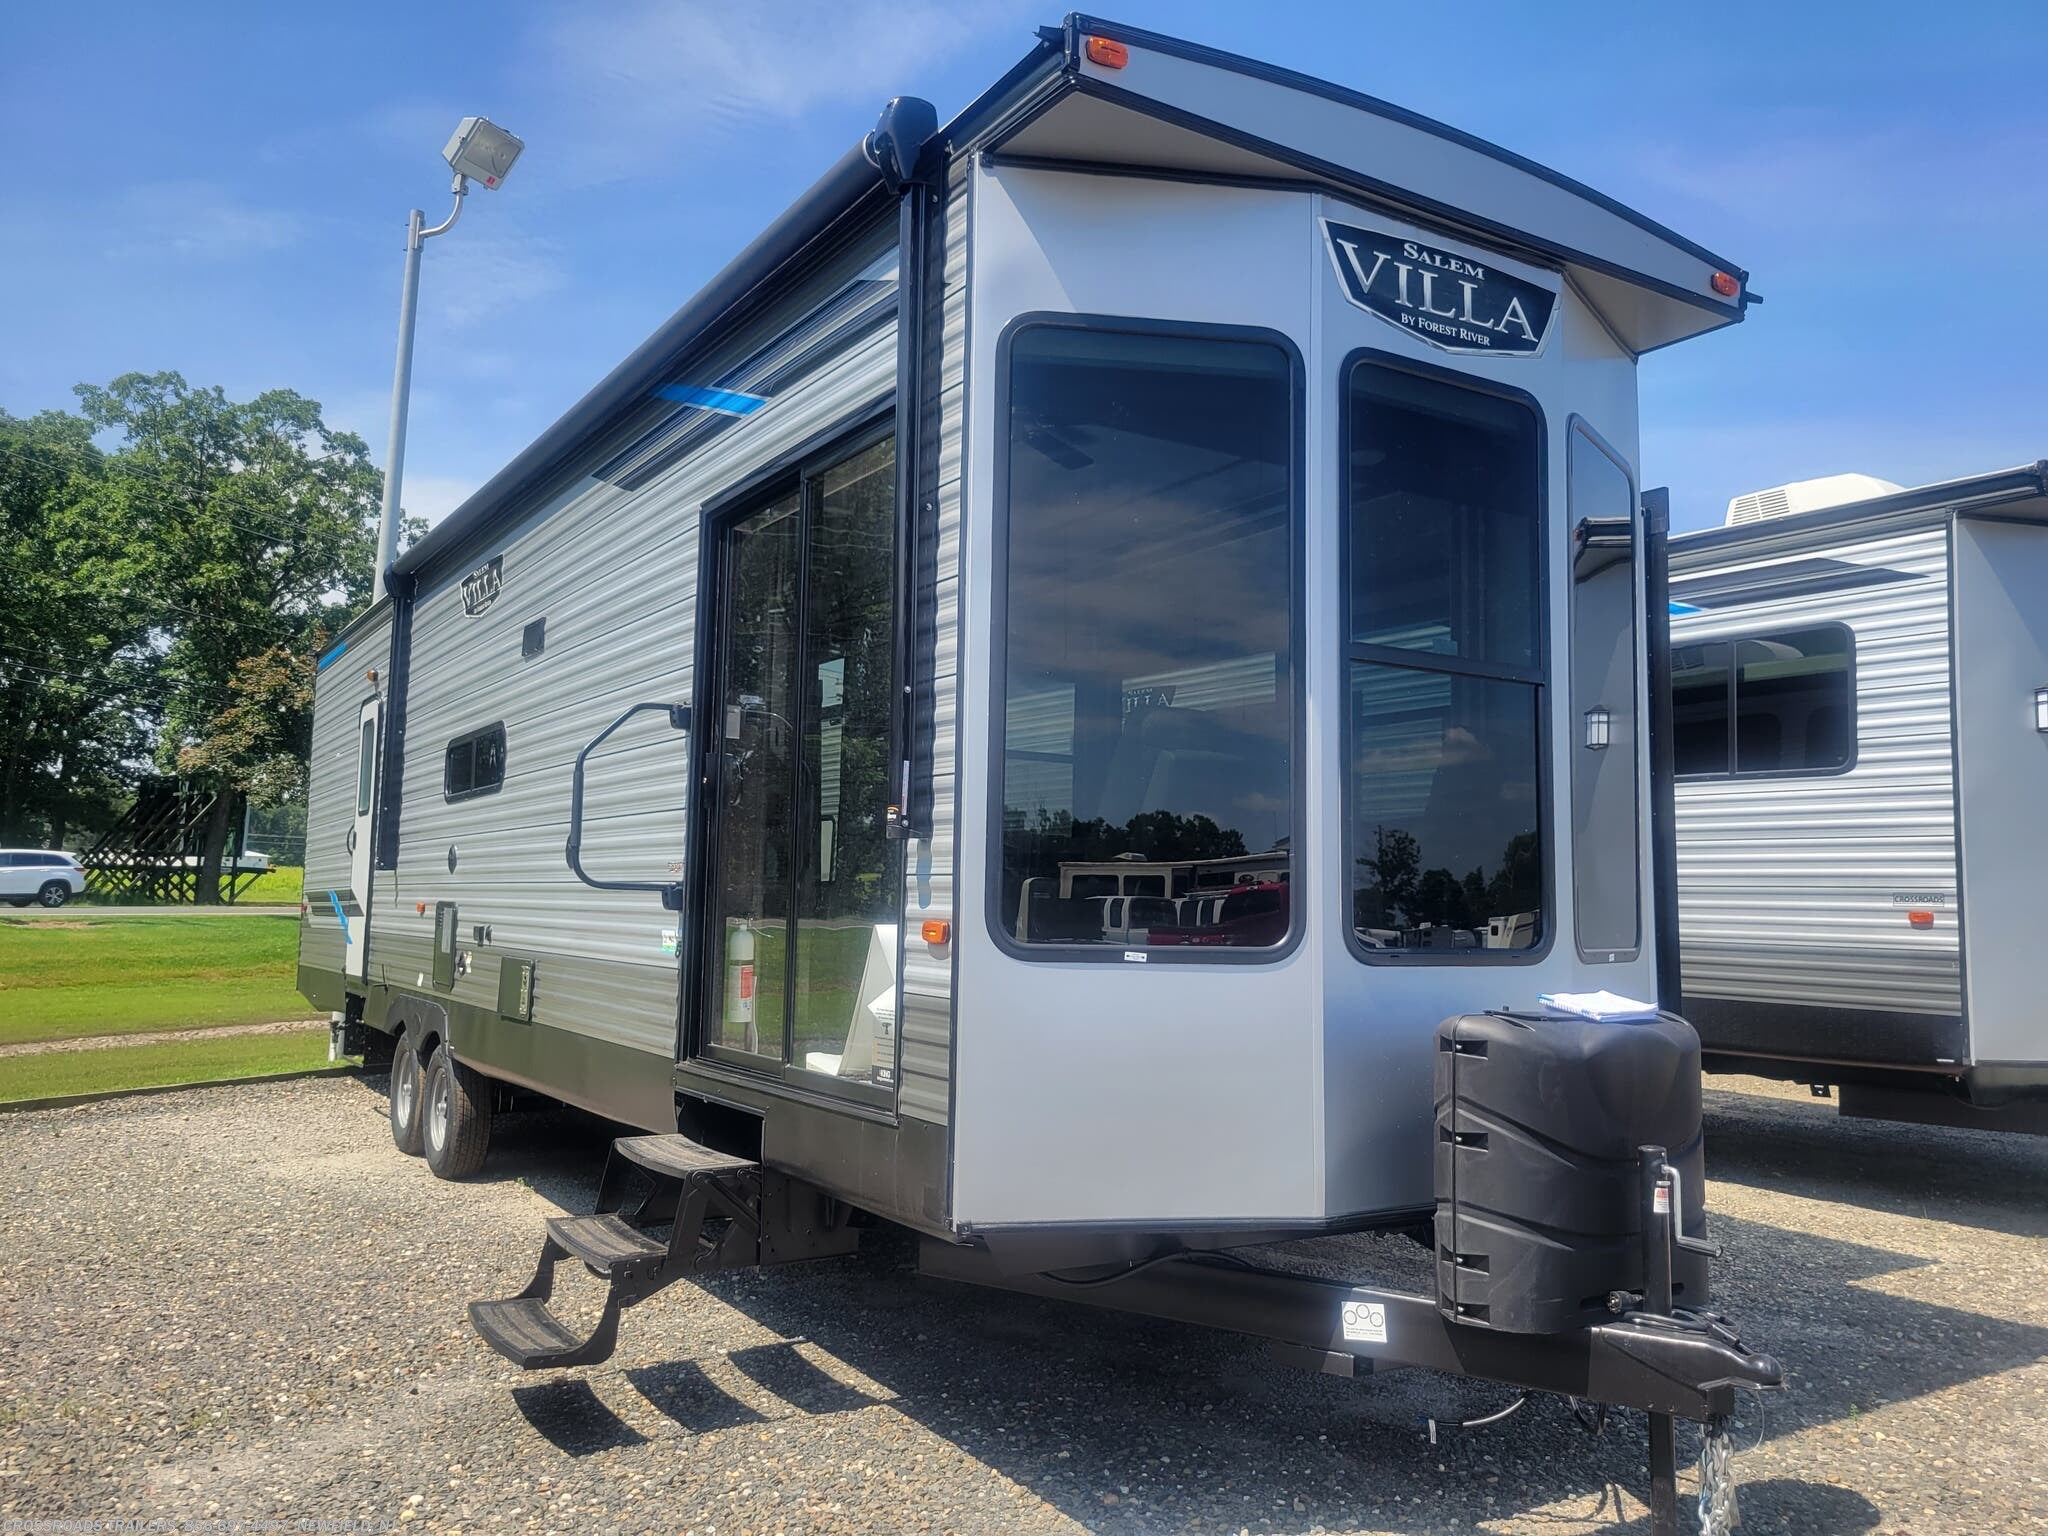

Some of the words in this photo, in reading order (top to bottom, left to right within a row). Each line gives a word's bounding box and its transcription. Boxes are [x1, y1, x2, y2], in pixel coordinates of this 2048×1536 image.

[1403, 242, 1485, 280] SALEM
[1337, 238, 1539, 343] VILLA
[1401, 312, 1415, 326] BY
[1418, 317, 1458, 337] FOREST
[1460, 327, 1491, 347] RIVER
[464, 571, 501, 608] VILLA
